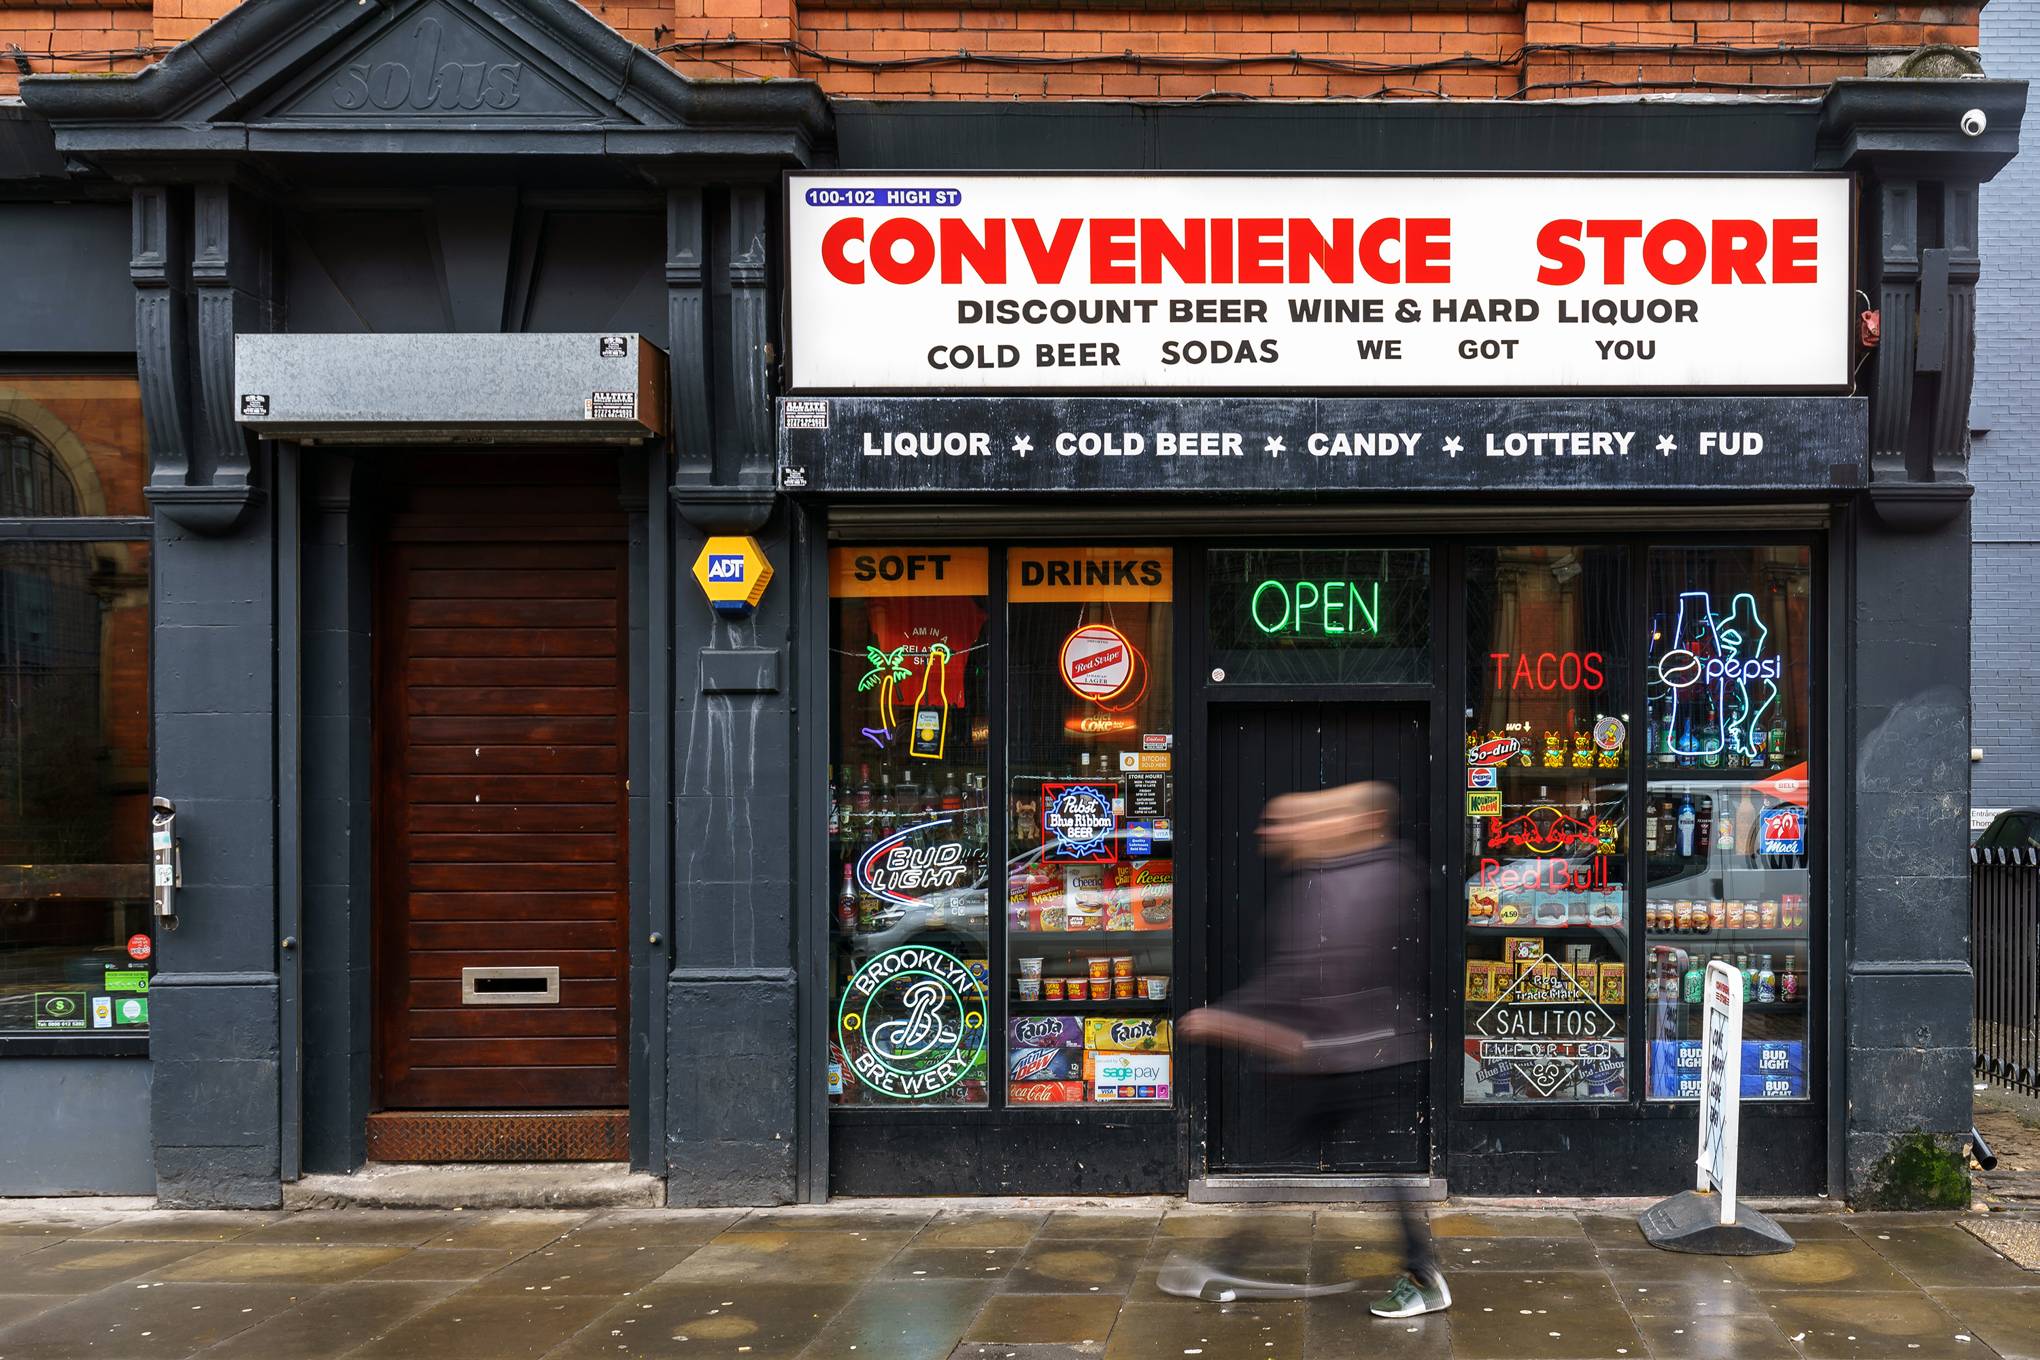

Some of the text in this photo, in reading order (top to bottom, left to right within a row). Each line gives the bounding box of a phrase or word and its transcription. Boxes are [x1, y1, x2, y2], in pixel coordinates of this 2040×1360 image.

[809, 190, 958, 204] 100-102 HIGH ST
[821, 216, 1818, 285] CONVENIENCE STORE
[958, 298, 1699, 326] DISCOUNT BEER WINE & HARD LIQUOR
[927, 339, 1656, 370] COLD BEER SODAS WE GOT YOU
[863, 432, 1764, 458] LIQUOR COLD BEER CANDY LOTTERY FUD
[709, 559, 744, 578] ADT
[854, 554, 952, 582] SOFT
[1021, 560, 1162, 586] DRINKS
[1252, 580, 1378, 635] OPEN
[912, 628, 927, 636] AM
[930, 628, 940, 638] IN
[1075, 652, 1121, 673] Red Stripe
[1490, 652, 1604, 691] TACOS
[1706, 655, 1781, 685] pepsi
[1080, 718, 1113, 732] Coke
[1470, 741, 1517, 760] So-duh
[1063, 796, 1098, 813] Pabst
[1050, 814, 1112, 827] Blue Ribbon
[1067, 827, 1093, 838] BEER
[1765, 840, 1798, 854] Mac's
[887, 843, 962, 871] BUD
[872, 866, 966, 890] LIGHT
[1118, 866, 1129, 876] Luc
[1480, 855, 1608, 890] Red Bull
[1141, 884, 1169, 896] Puffs
[856, 950, 974, 996] BROOKLYN
[1515, 988, 1580, 1000] Trade Mark
[56, 1001, 64, 1010] S
[1015, 1018, 1063, 1042] Fanta
[1497, 1010, 1596, 1035] SALITOS
[1112, 1020, 1157, 1044] Fanta
[1485, 1043, 1606, 1056] IMPORTED
[1680, 1049, 1702, 1058] BUD
[1762, 1050, 1787, 1060] BUD
[854, 1048, 967, 1094] BREWERY
[1676, 1058, 1702, 1067] LIGH
[1760, 1060, 1789, 1069] LIGHT
[1103, 1065, 1160, 1081] sage pay
[1478, 1066, 1499, 1082] Blue
[1680, 1080, 1702, 1090] BUD
[1765, 1082, 1789, 1090] BUD
